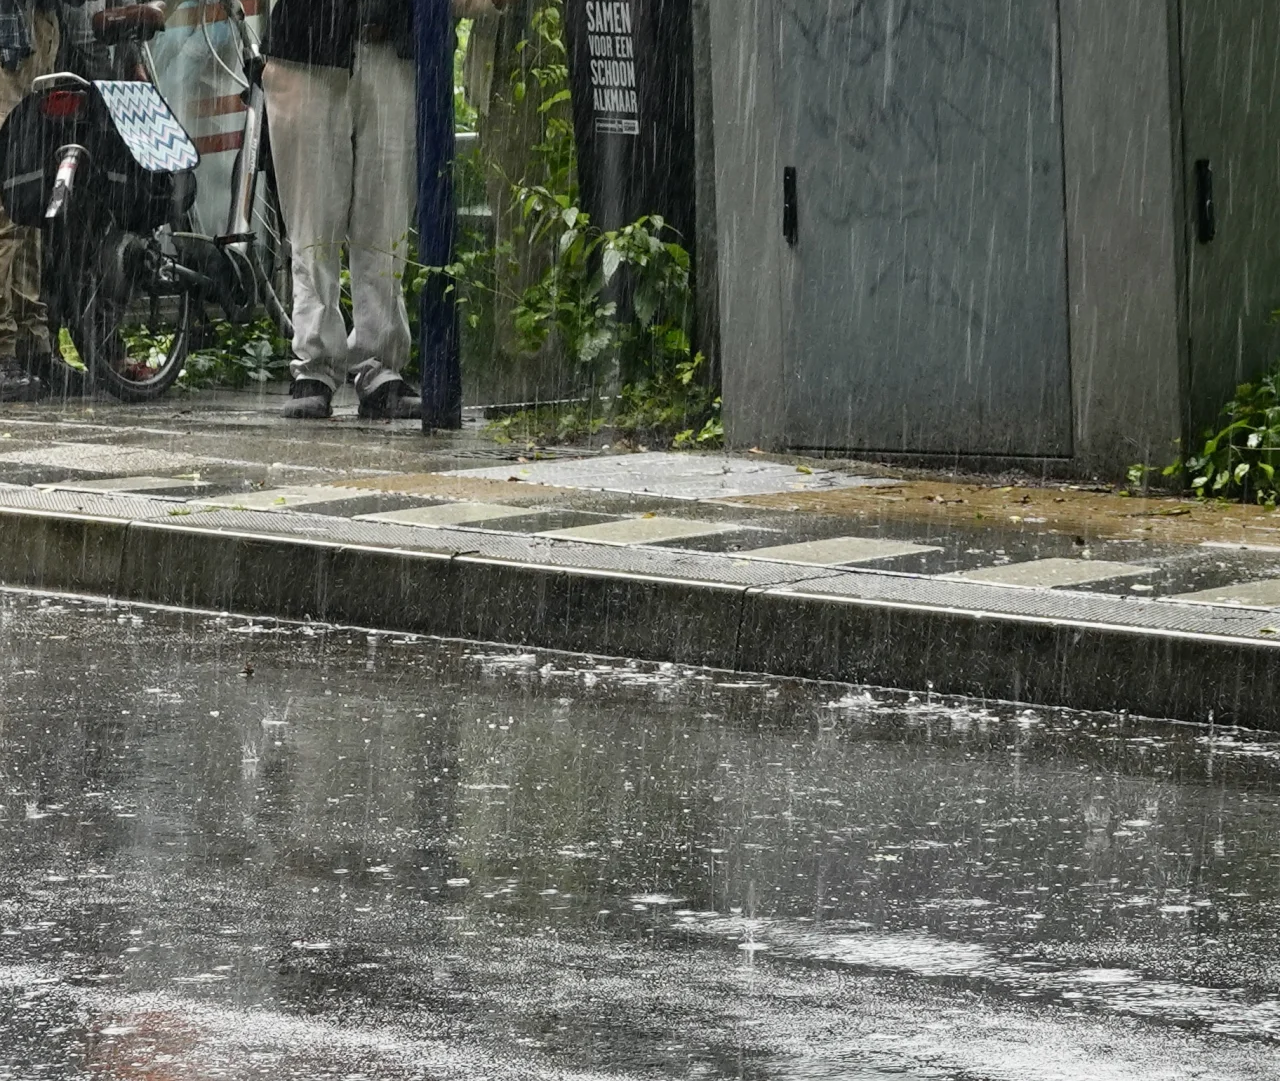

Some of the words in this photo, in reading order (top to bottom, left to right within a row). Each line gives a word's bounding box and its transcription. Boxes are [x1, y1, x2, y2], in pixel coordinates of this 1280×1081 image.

[585, 0, 632, 34] SAMEN
[588, 34, 614, 58] VOOR
[614, 35, 634, 59] EEN
[590, 59, 636, 88] SCHOON
[593, 87, 638, 114] ALKMAAR
